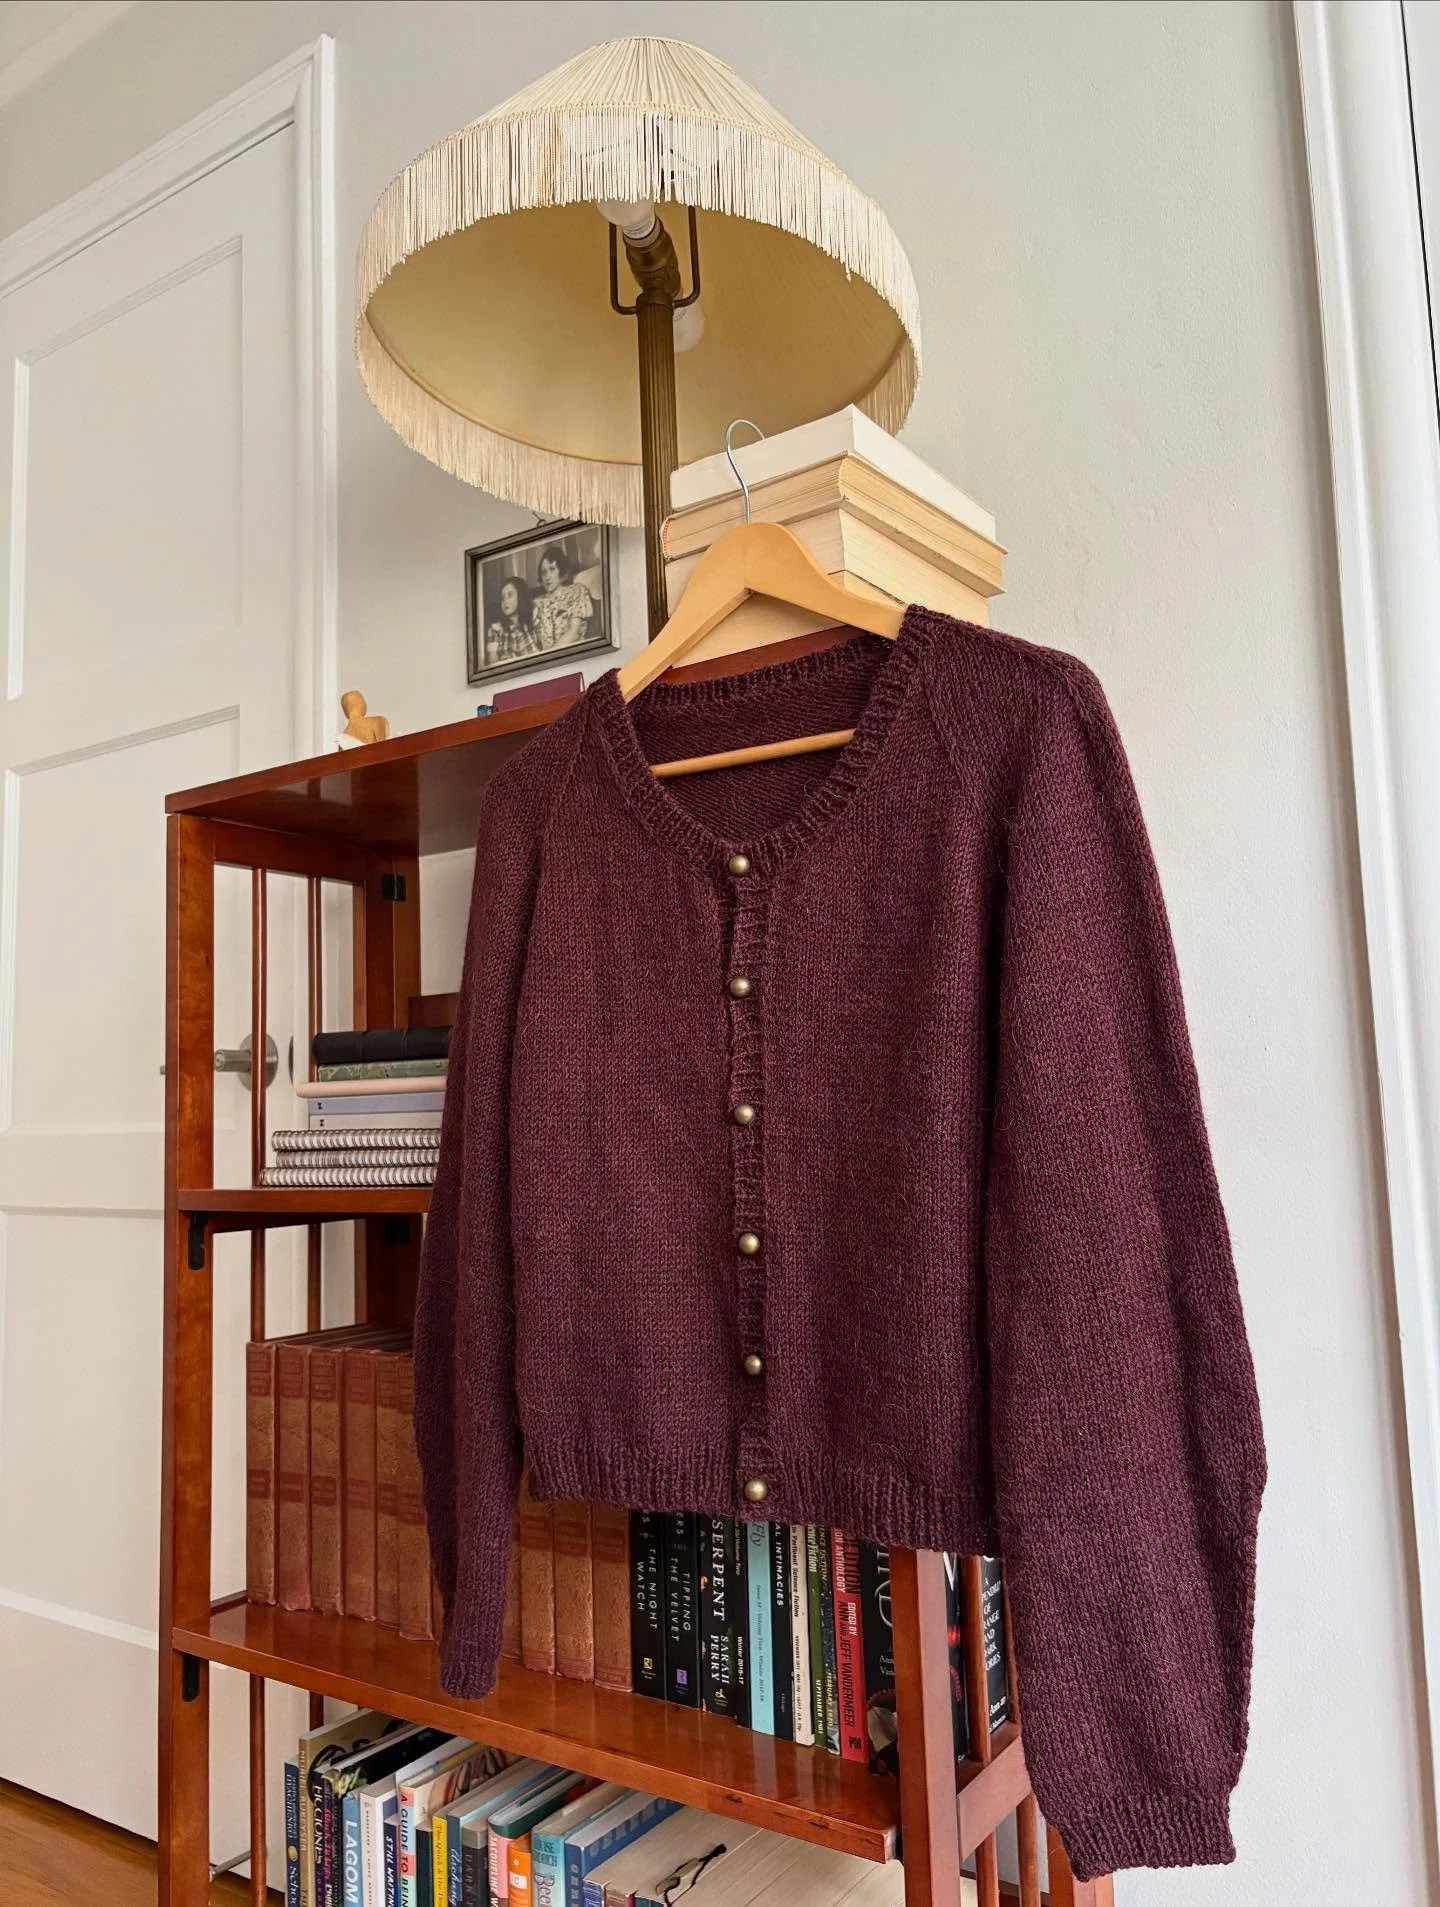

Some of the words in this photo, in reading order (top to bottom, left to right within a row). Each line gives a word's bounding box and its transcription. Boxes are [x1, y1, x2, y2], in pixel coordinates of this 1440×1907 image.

[750, 1523, 766, 1547] Fly
[791, 1535, 799, 1566] Pertinent
[648, 1549, 657, 1572] THE
[669, 1557, 678, 1583] THE
[711, 1518, 724, 1621] SERPENT
[775, 1541, 784, 1606] INTIMACIES
[807, 1544, 819, 1573] Fiction
[819, 1548, 828, 1581] FICTION
[835, 1544, 846, 1592] ANTHOLOGY
[635, 1561, 645, 1611] WATCH
[649, 1583, 658, 1629] NIGHT
[681, 1572, 692, 1632] TIPPING
[670, 1592, 679, 1642] VELVET
[838, 1600, 849, 1621] ANN
[848, 1602, 857, 1624] EDITED
[710, 1634, 719, 1681] PERRY
[720, 1634, 729, 1684] SARAH
[840, 1636, 850, 1659] JEFF
[815, 1679, 823, 1717] SEPTEMBER
[841, 1662, 854, 1727] VANDERMEER
[401, 1792, 408, 1803] A
[385, 1835, 394, 1864] STILL
[400, 1808, 409, 1850] GUIDE
[344, 1819, 358, 1904] LAGOM
[401, 1855, 409, 1873] TO
[490, 1834, 498, 1894] JACQUELINE
[386, 1866, 395, 1907] WRITIN
